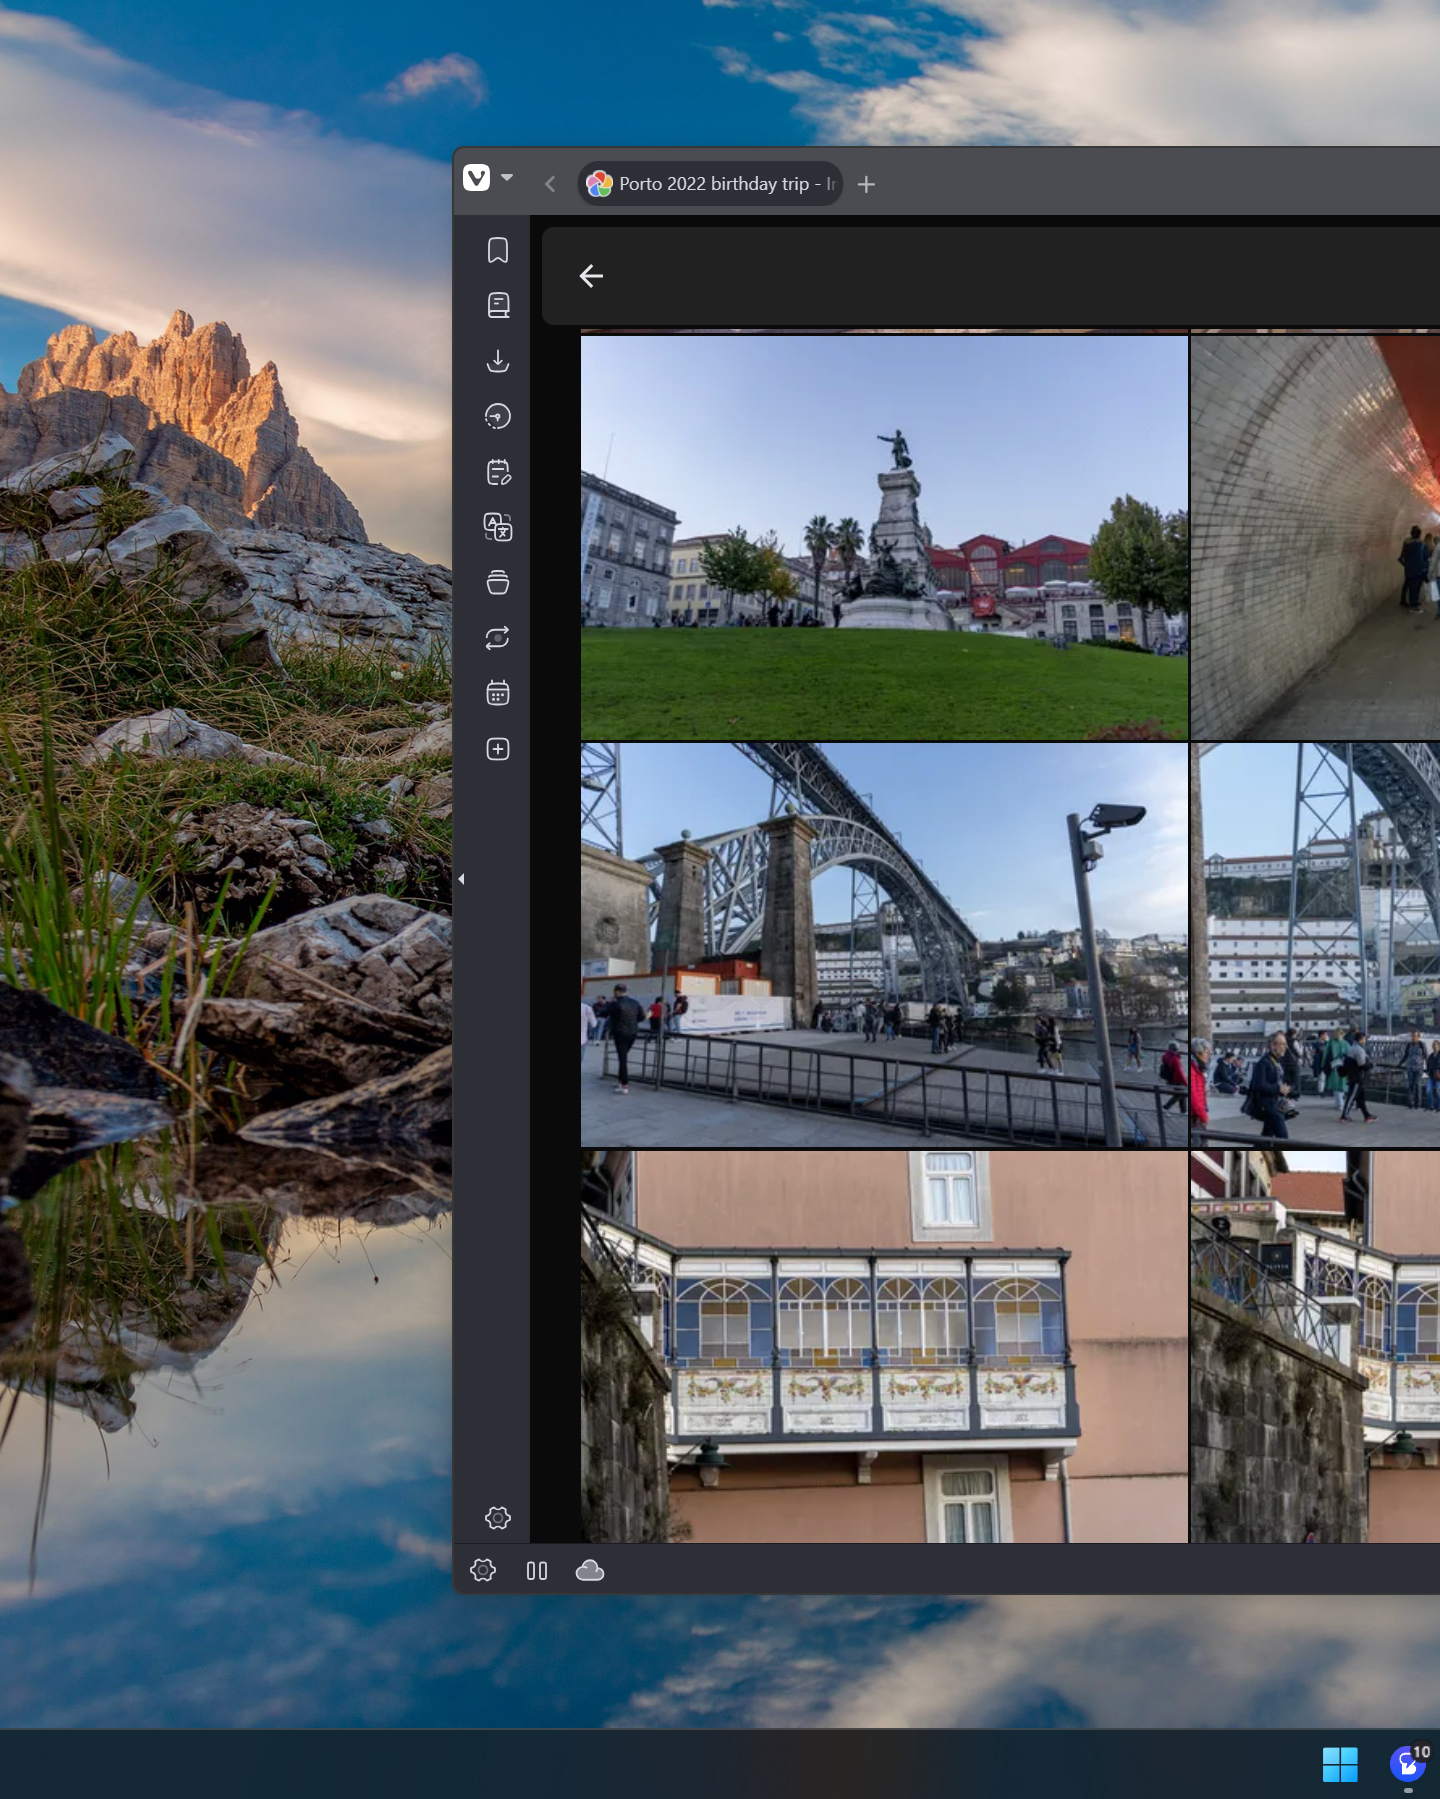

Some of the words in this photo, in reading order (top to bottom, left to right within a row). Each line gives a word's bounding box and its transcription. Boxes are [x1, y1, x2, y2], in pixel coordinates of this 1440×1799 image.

[621, 176, 662, 191] Porto
[668, 176, 706, 191] 2022
[712, 175, 777, 195] birthday
[782, 176, 810, 195] trip
[1413, 1745, 1431, 1758] 10
